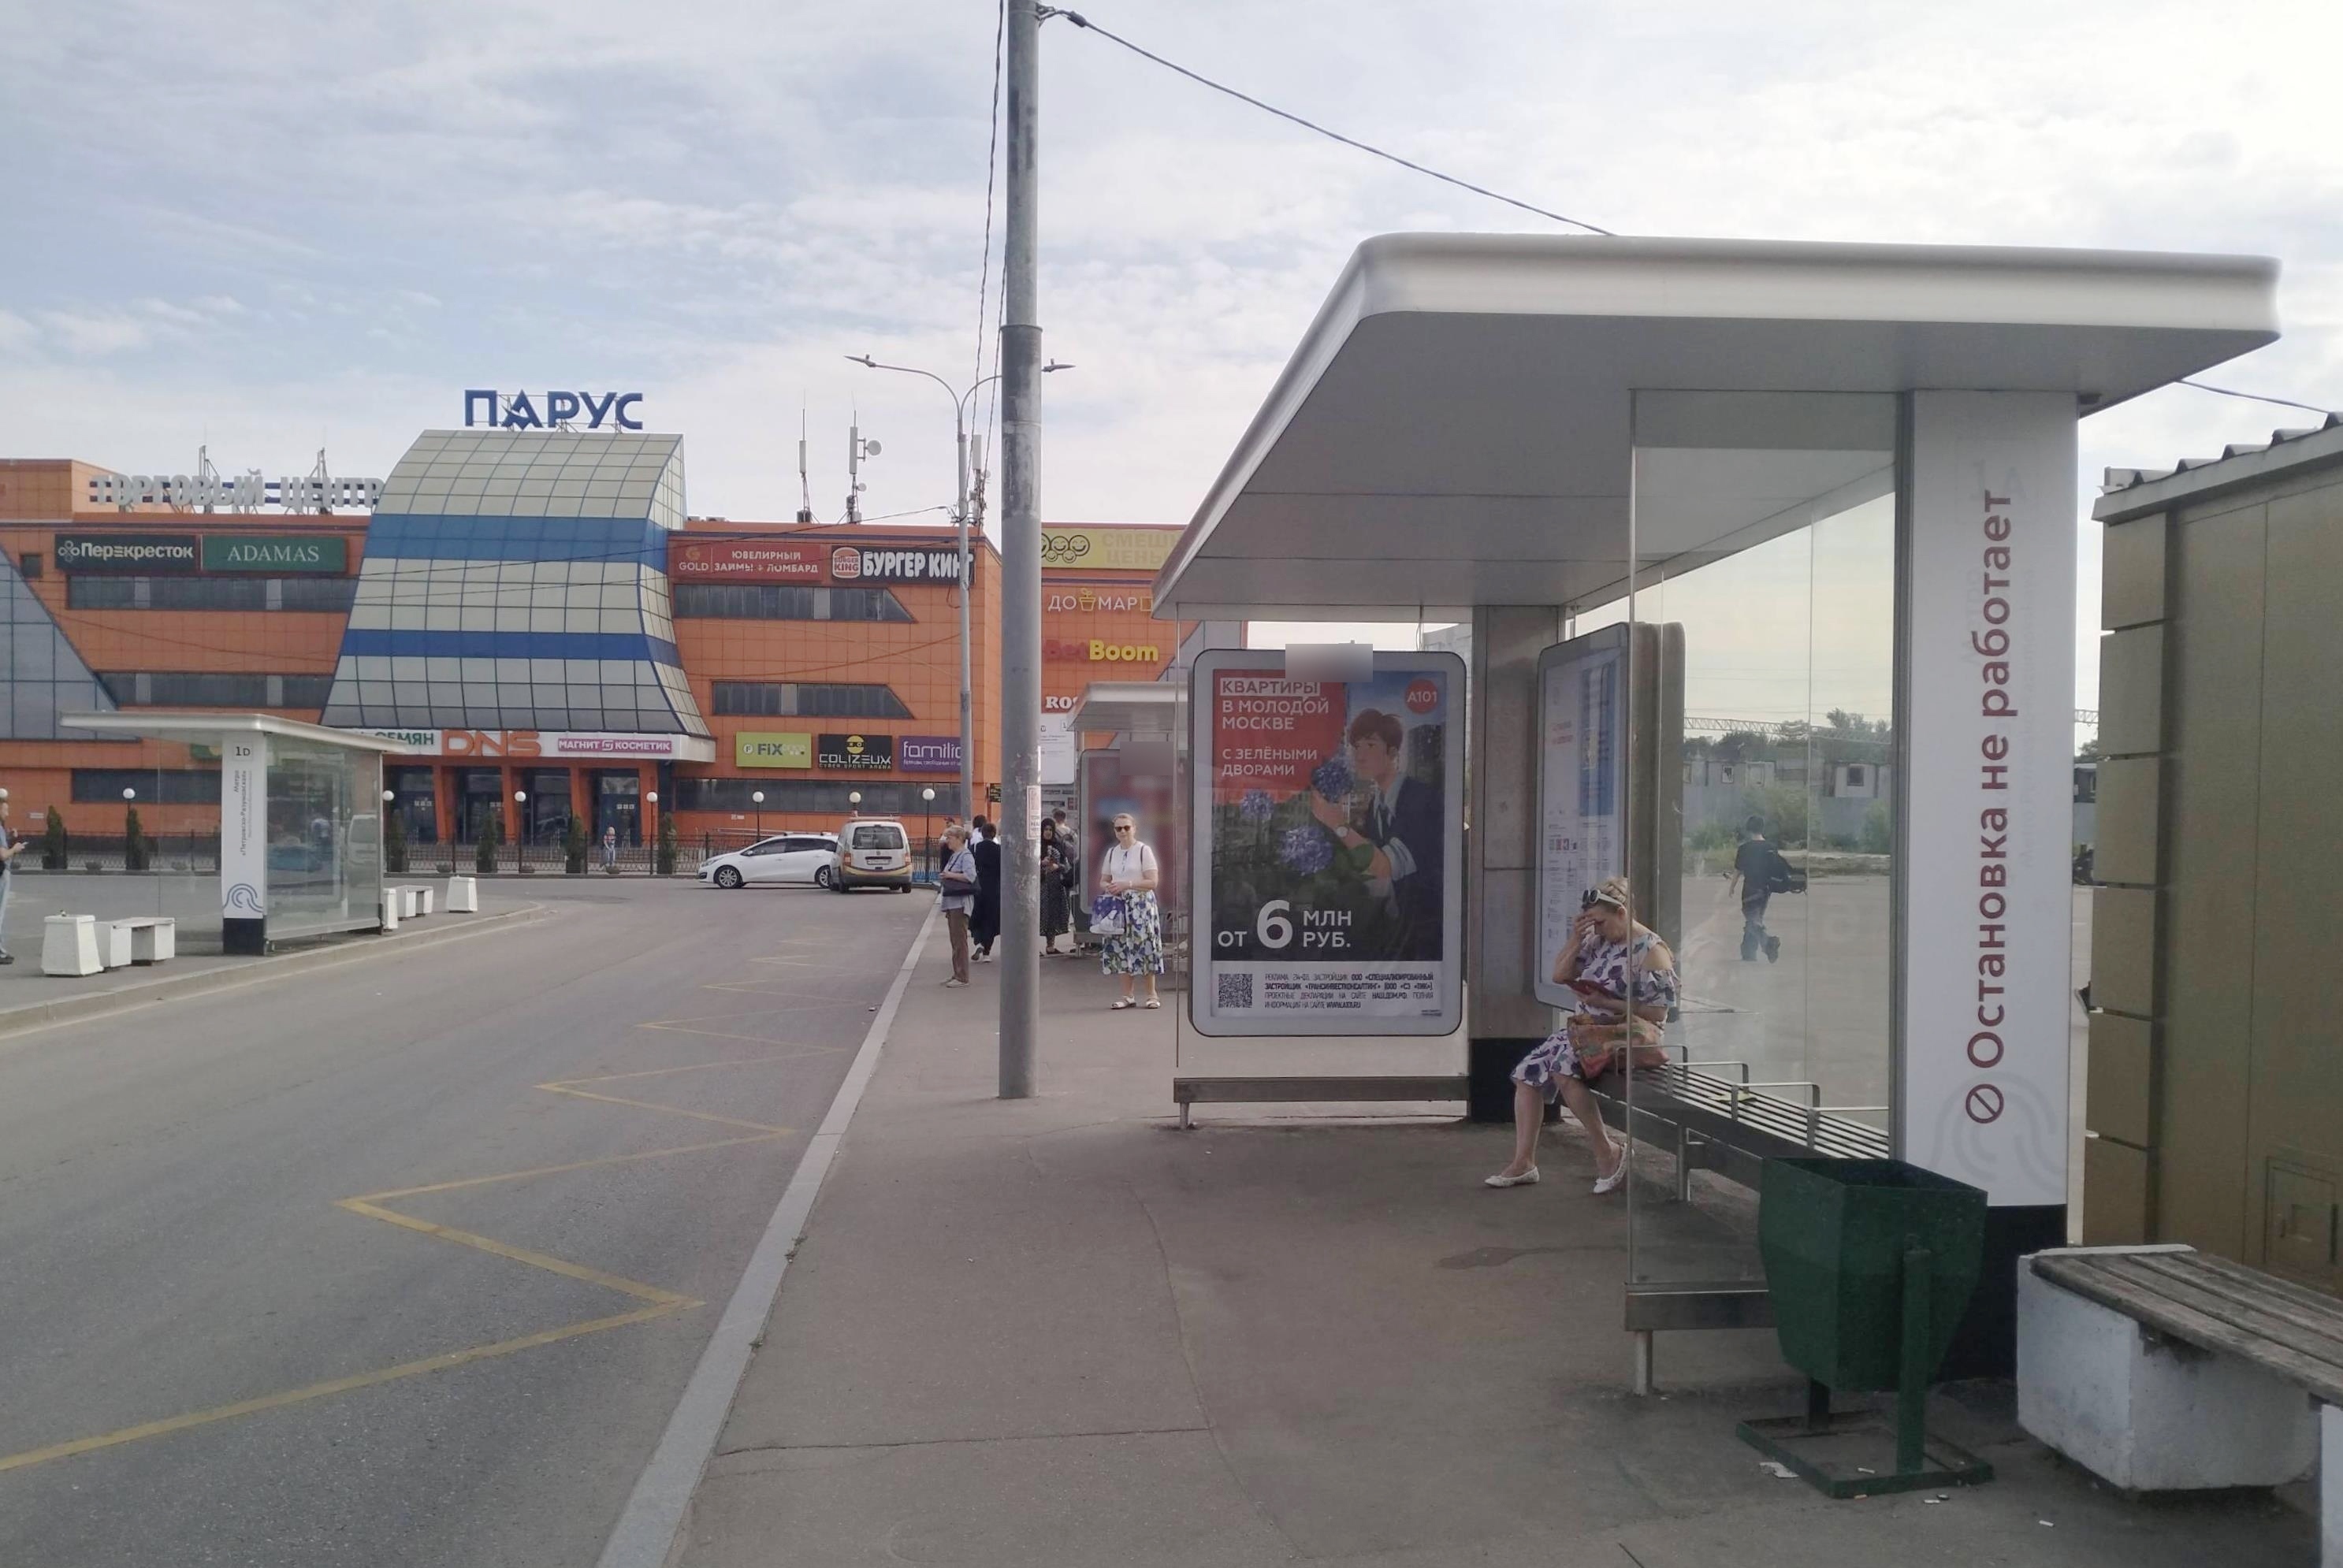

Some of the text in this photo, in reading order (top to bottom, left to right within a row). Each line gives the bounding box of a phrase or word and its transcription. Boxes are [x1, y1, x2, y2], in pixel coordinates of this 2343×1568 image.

[464, 389, 643, 430] ПАРУС
[80, 542, 193, 561] Перекресток
[227, 545, 320, 562] ADAMAS
[732, 550, 801, 560] ЮВЕЛИРНЫЙ
[679, 562, 708, 571] GOLD
[767, 563, 818, 573] ЛОМБАРД
[863, 552, 926, 578] БУРГЕР
[1222, 680, 1318, 693] КВАРТИРЫ
[1222, 697, 1330, 715] В МОЛОДОЙ
[1222, 716, 1295, 730] МОСКВЕ
[441, 730, 541, 756] DNS
[558, 741, 670, 751] МАГНИТ КОСМЕТИК
[757, 743, 783, 756] FIX
[236, 746, 251, 756] 1D
[1222, 746, 1318, 760] С ЗЕЛЁНЫМИ
[819, 754, 892, 764] COLIZEUM
[1222, 764, 1295, 777] ДВОРАМИ
[1967, 489, 2018, 1068] Остановка не работает
[1218, 899, 1352, 949] ОТ 6 МЛН
[1303, 931, 1351, 948] РУБ.
